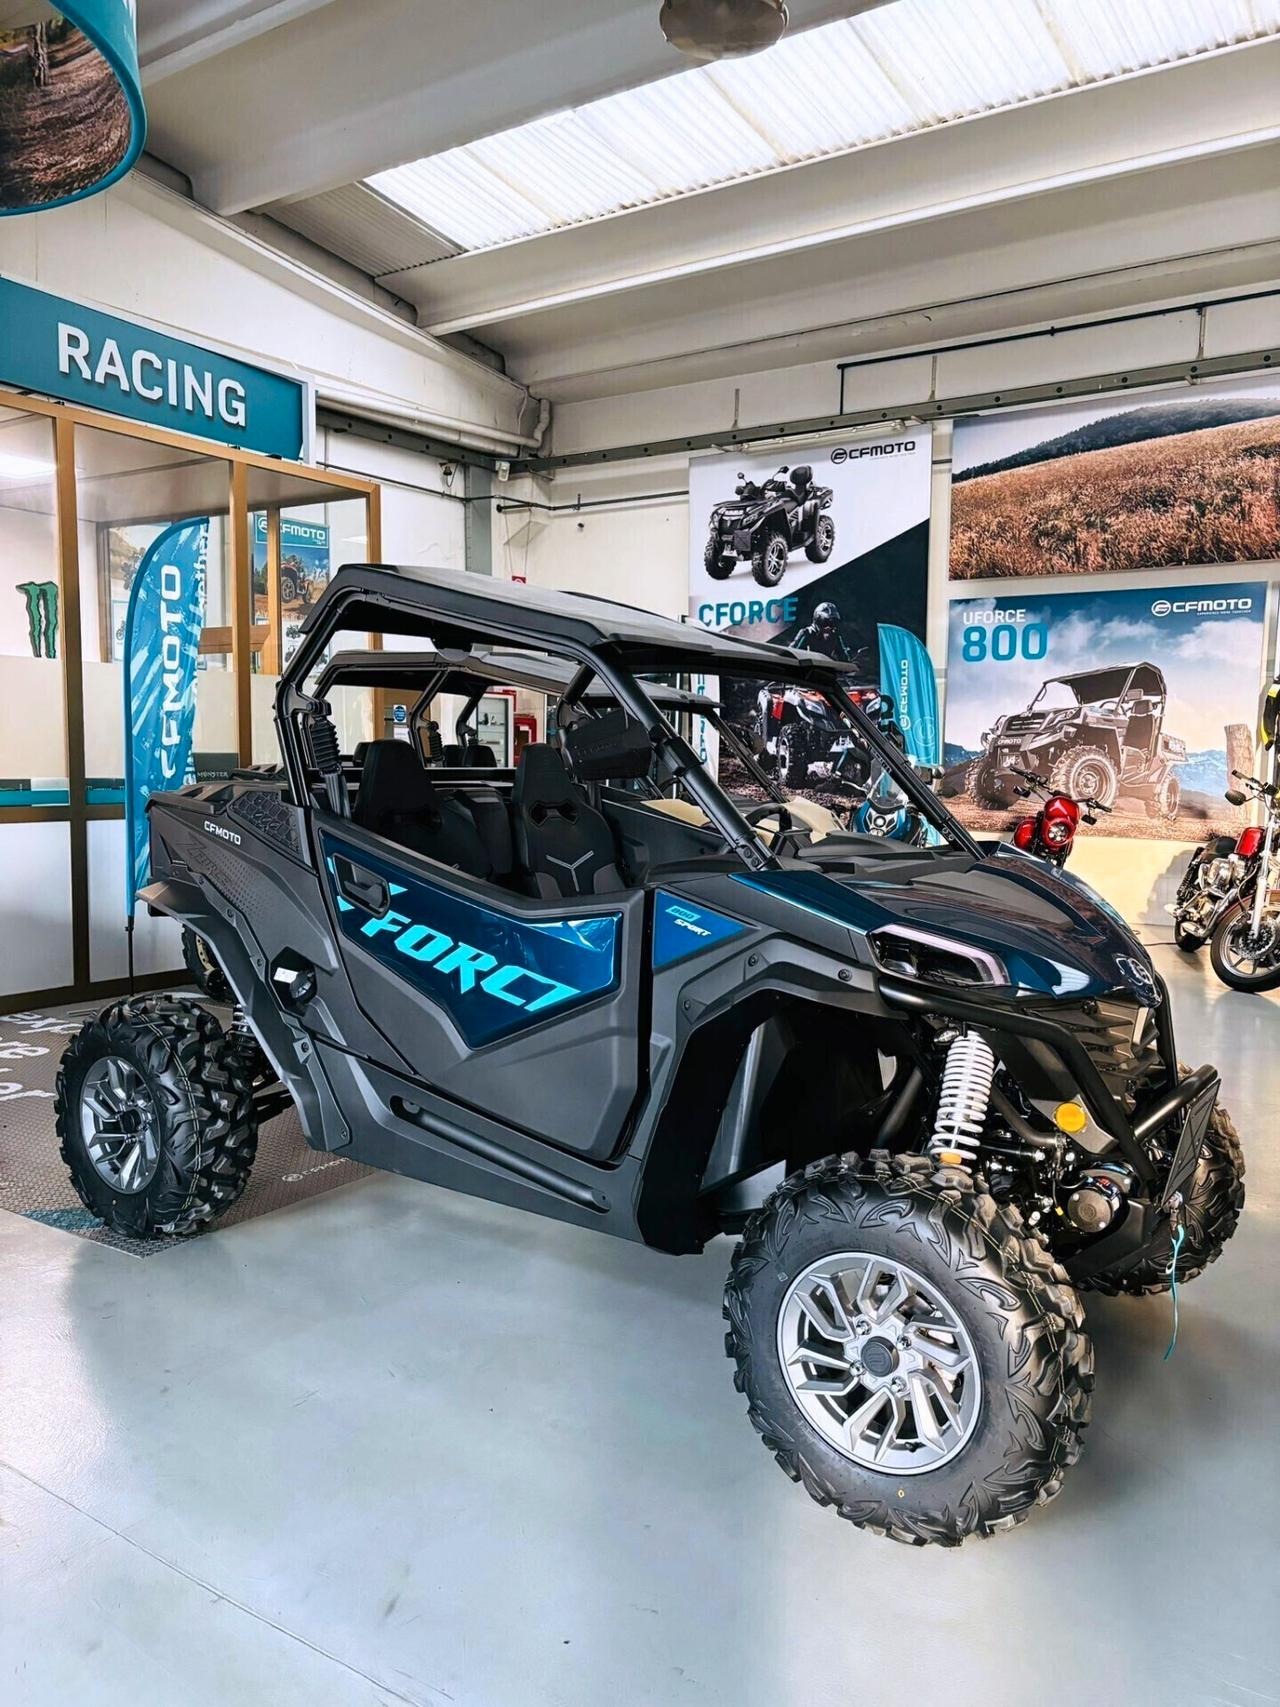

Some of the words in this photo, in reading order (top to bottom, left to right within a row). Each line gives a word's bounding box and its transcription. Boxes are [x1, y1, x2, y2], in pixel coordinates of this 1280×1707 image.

[58, 322, 246, 427] RACING
[848, 441, 916, 459] CFMOTO
[280, 522, 326, 540] FMOTO
[698, 597, 798, 627] CFORCE
[963, 608, 1026, 625] UFORCE
[1172, 598, 1253, 613] CFMOTO
[962, 623, 1048, 662] 800
[160, 564, 182, 779] CFMOTO
[204, 820, 241, 845] CFMOTO
[673, 918, 712, 937] SPORT
